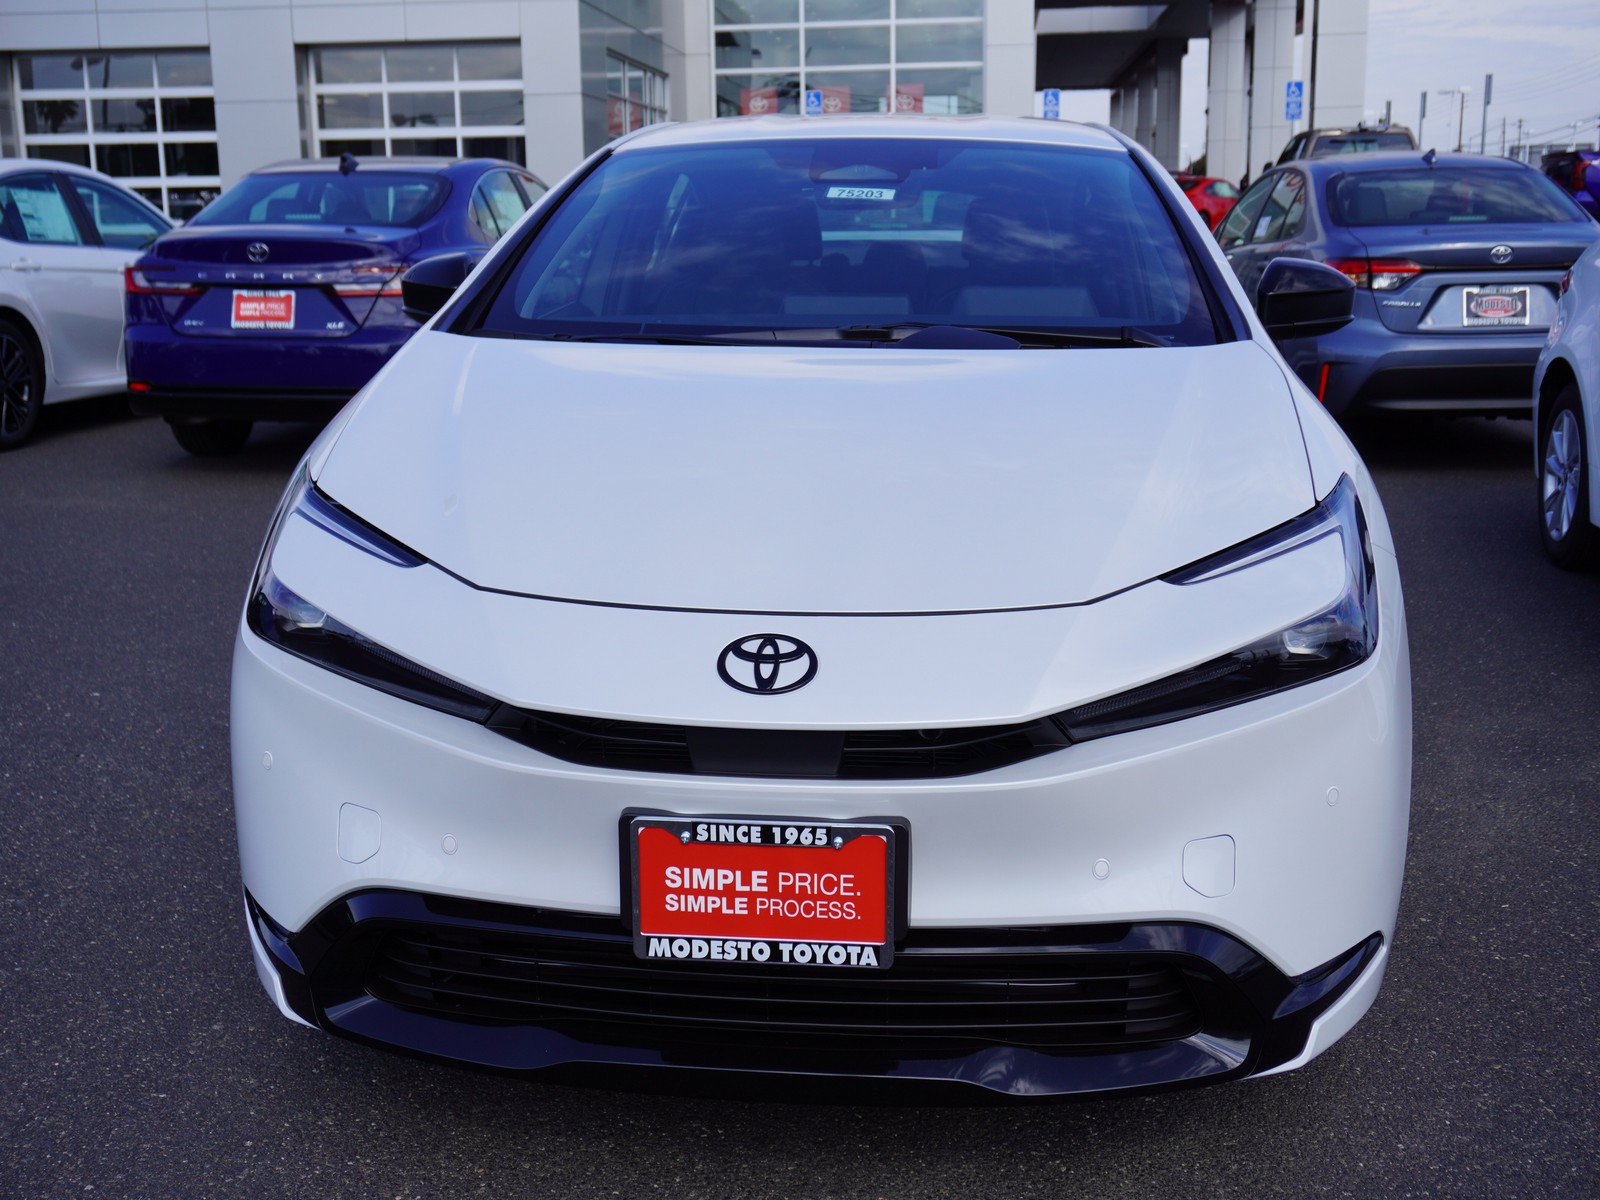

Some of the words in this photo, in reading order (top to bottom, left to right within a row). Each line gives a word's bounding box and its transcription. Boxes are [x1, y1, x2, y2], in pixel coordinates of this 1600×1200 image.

[836, 189, 884, 199] 75203
[696, 823, 762, 844] SINCE
[772, 826, 829, 846] 1965
[664, 866, 768, 892] SIMPLE
[778, 872, 861, 897] PRICE.
[664, 894, 749, 915] SIMPLE
[756, 898, 862, 920] PROCESS.
[648, 937, 771, 962] MODESTO
[779, 942, 878, 967] TOYOTA
